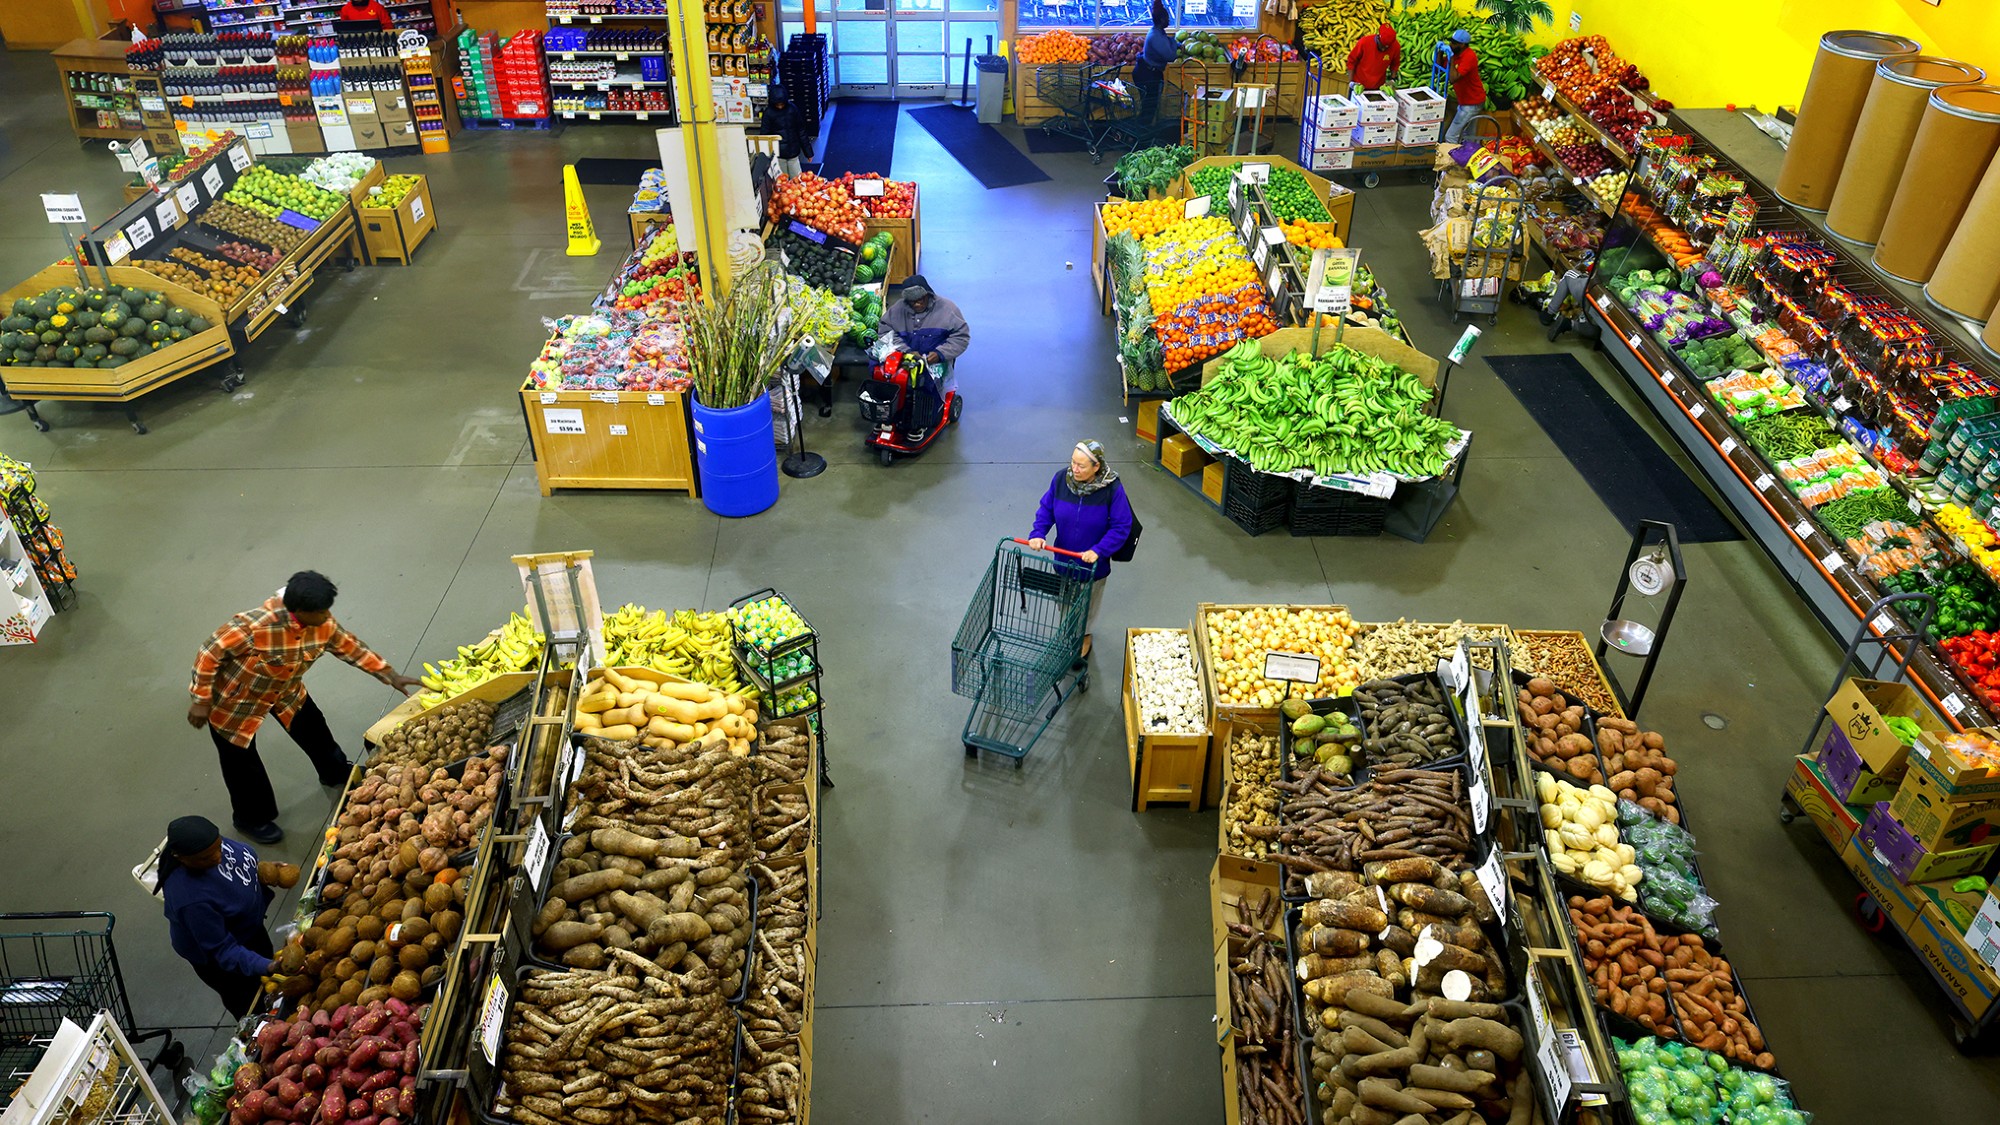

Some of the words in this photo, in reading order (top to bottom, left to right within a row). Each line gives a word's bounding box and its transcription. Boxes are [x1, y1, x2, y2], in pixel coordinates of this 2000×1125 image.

[400, 36, 426, 49] pop
[1920, 758, 1953, 791] PEPPERS
[217, 840, 237, 882] best
[235, 846, 257, 886] day
[1853, 864, 1895, 912] BANANAS
[1922, 943, 1968, 998] BANANAS
